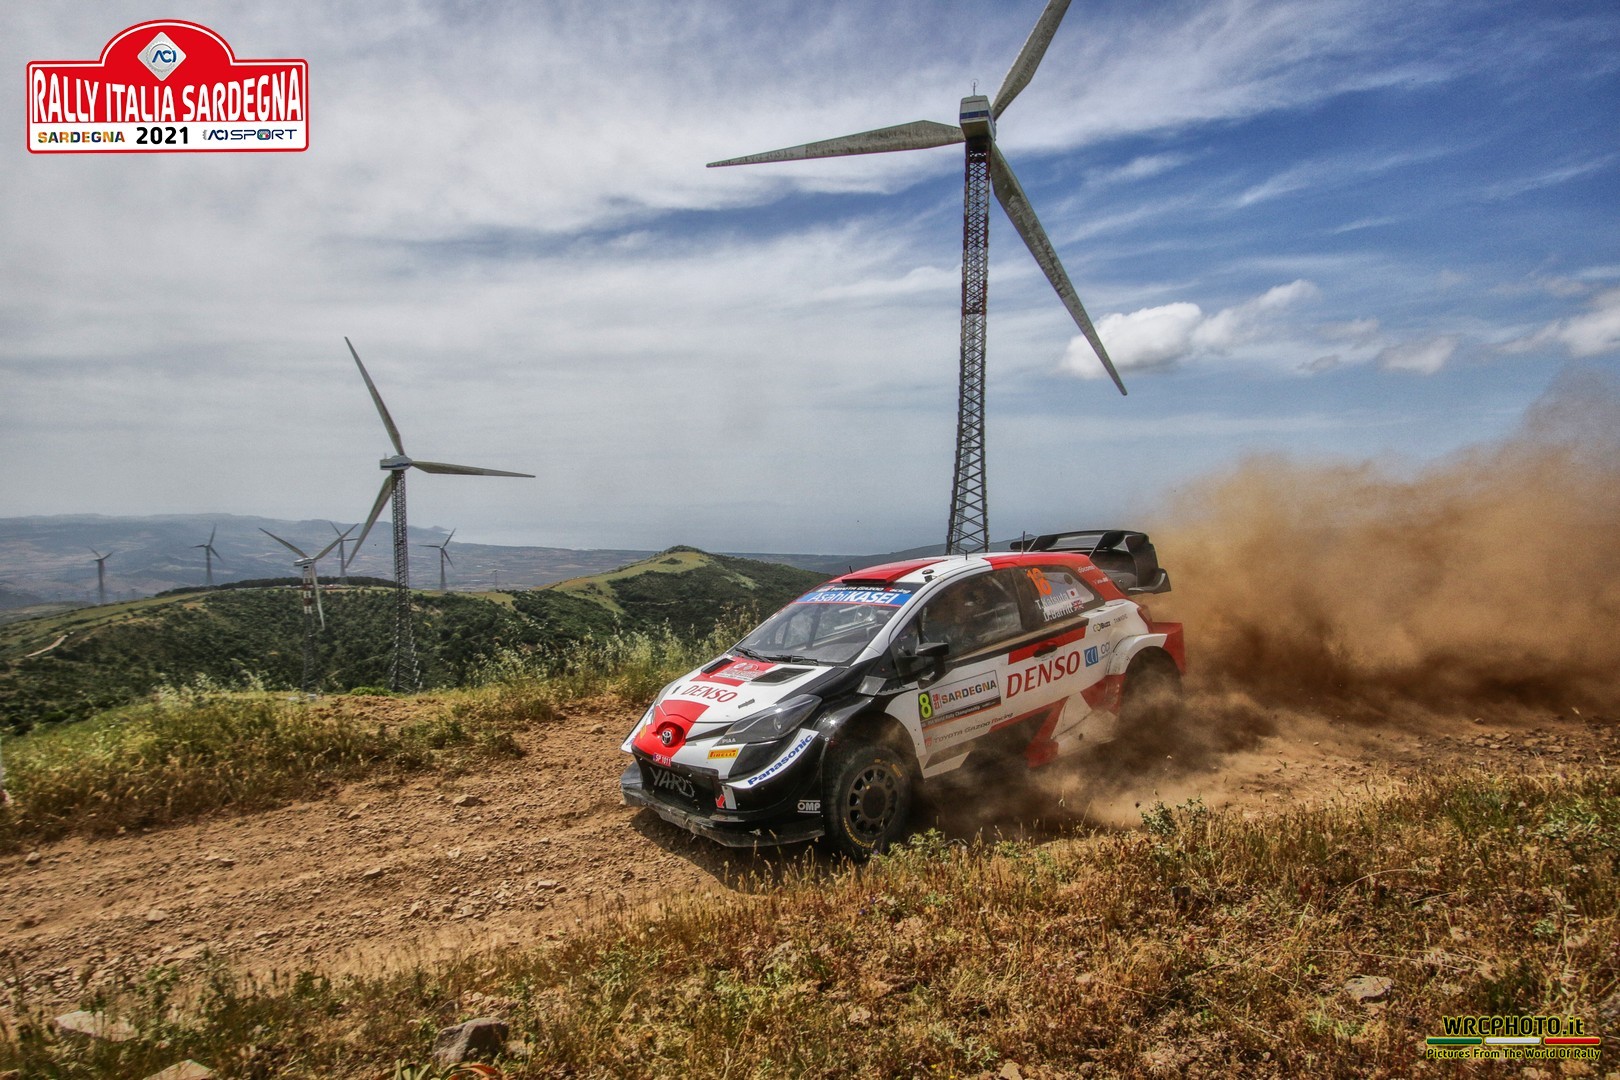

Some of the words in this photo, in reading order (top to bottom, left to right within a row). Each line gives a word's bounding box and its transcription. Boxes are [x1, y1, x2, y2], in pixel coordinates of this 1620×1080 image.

[1006, 651, 1080, 699] DENSO
[681, 685, 738, 703] DENSO
[941, 680, 997, 705] SARDEGNA
[919, 693, 932, 719] 8
[934, 730, 963, 743] TOYOTA
[747, 734, 813, 786] Panasonic
[649, 766, 695, 798] YARIS
[797, 802, 821, 811] OMP
